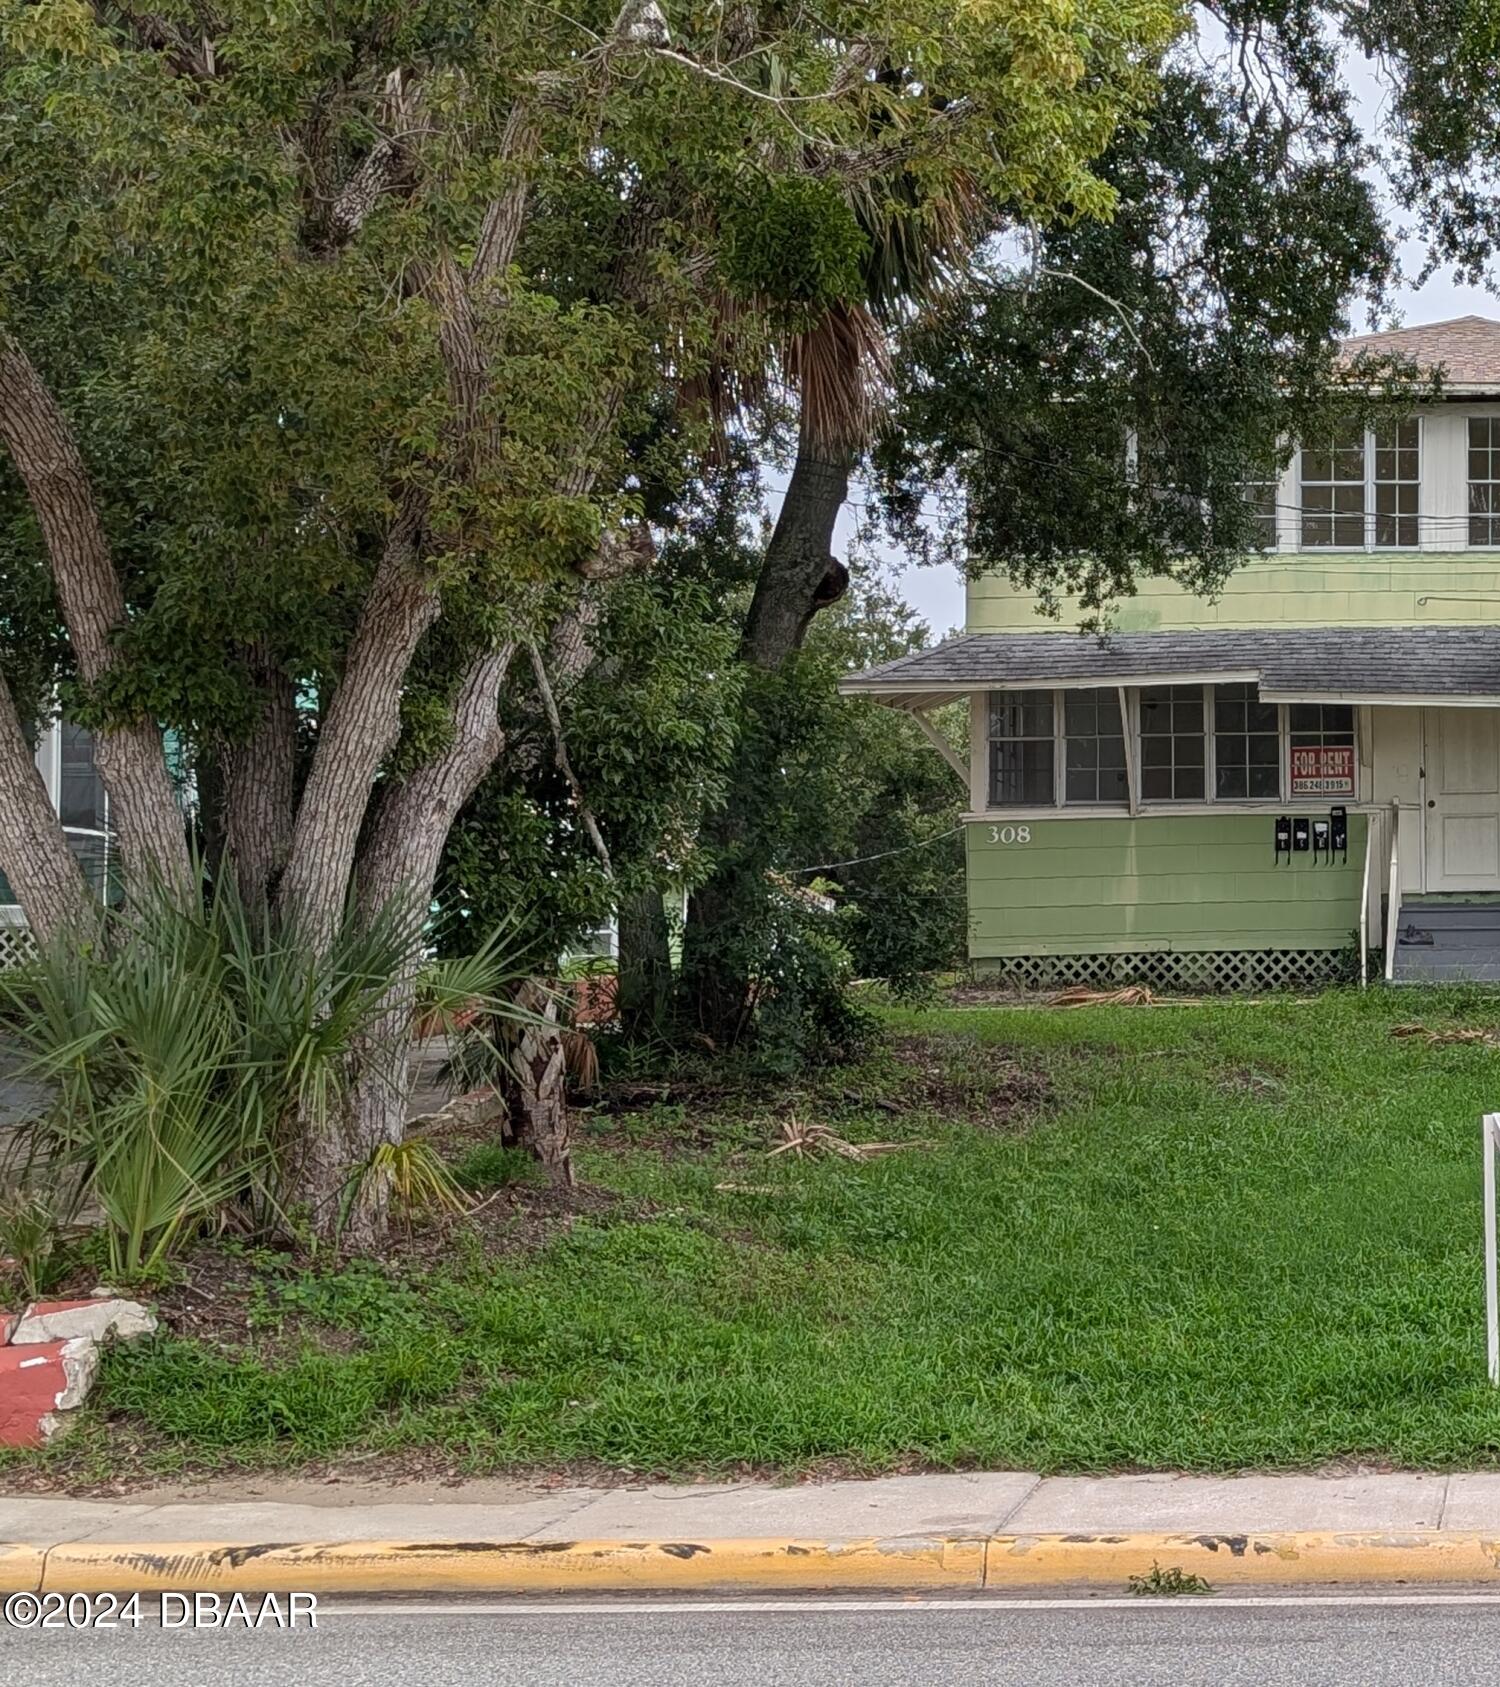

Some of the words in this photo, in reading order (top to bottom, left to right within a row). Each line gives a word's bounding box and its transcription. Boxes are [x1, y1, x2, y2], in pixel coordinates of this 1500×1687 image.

[1294, 752, 1316, 775] FOR
[1320, 752, 1349, 774] RENT
[987, 826, 1031, 844] 308
